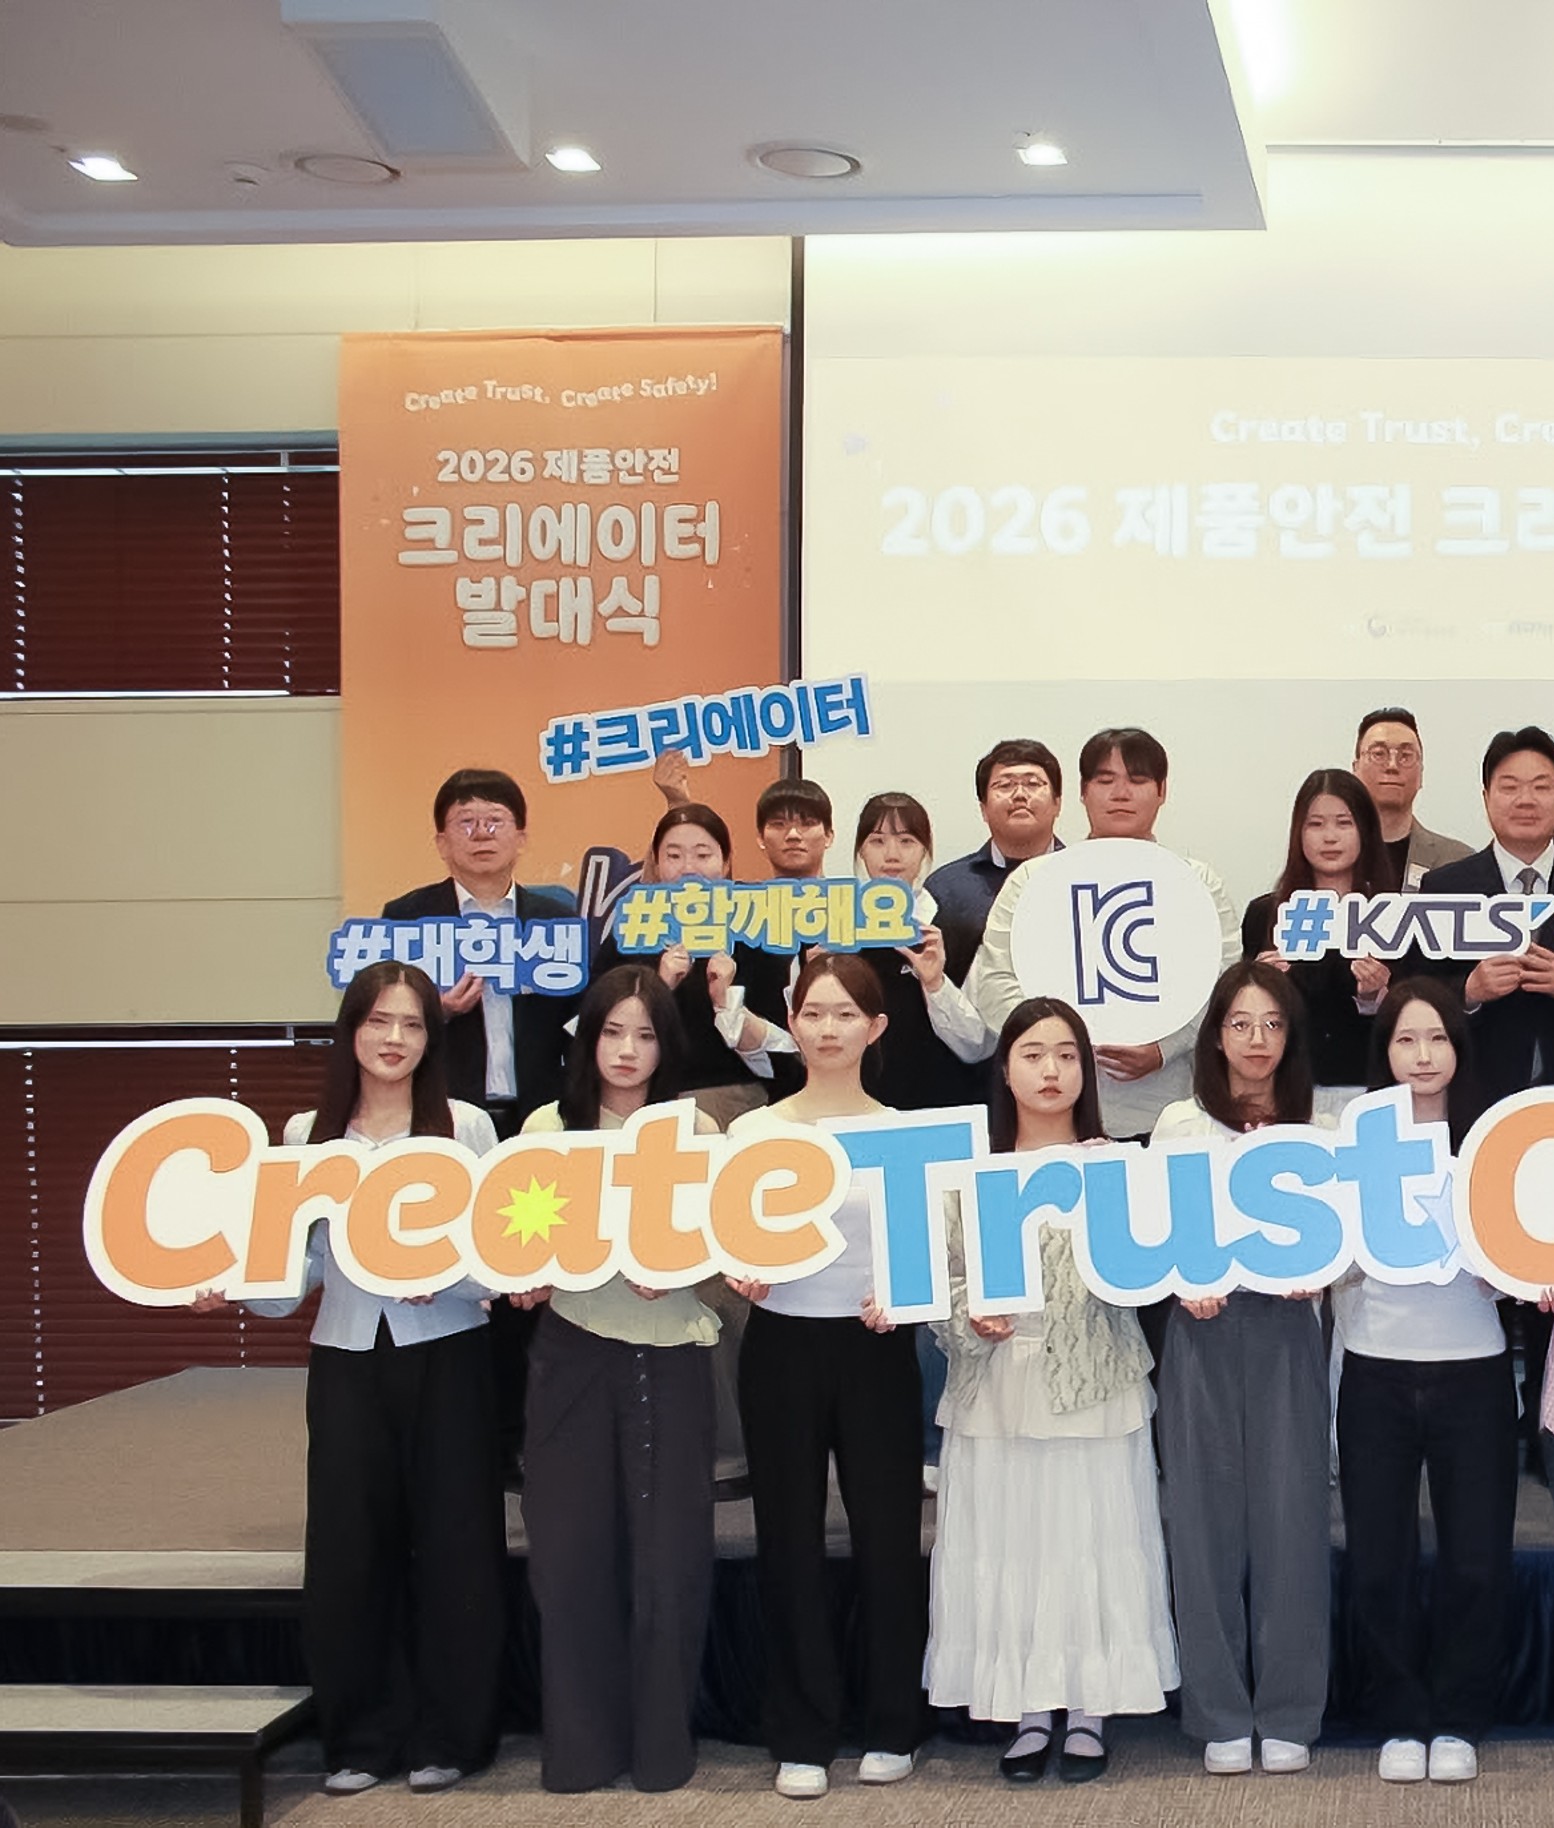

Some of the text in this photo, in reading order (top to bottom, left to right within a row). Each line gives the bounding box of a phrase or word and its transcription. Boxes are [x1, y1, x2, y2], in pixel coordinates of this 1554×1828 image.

[404, 385, 478, 412] Create
[560, 381, 634, 409] Create
[639, 372, 718, 400] Safety!
[436, 447, 681, 485] 2026 제품안전
[1209, 410, 1347, 445] Create
[1361, 410, 1481, 452] Trust,
[397, 500, 720, 568] 크리에이터
[881, 484, 1093, 560] 2026
[1113, 482, 1413, 560] 제품안전
[455, 574, 662, 649] 발대식
[547, 678, 870, 775] #크리에이터
[333, 919, 585, 989] #대학생
[619, 882, 915, 955] #함께해요
[102, 1113, 836, 1291] Create
[835, 1103, 1448, 1308] Trust
